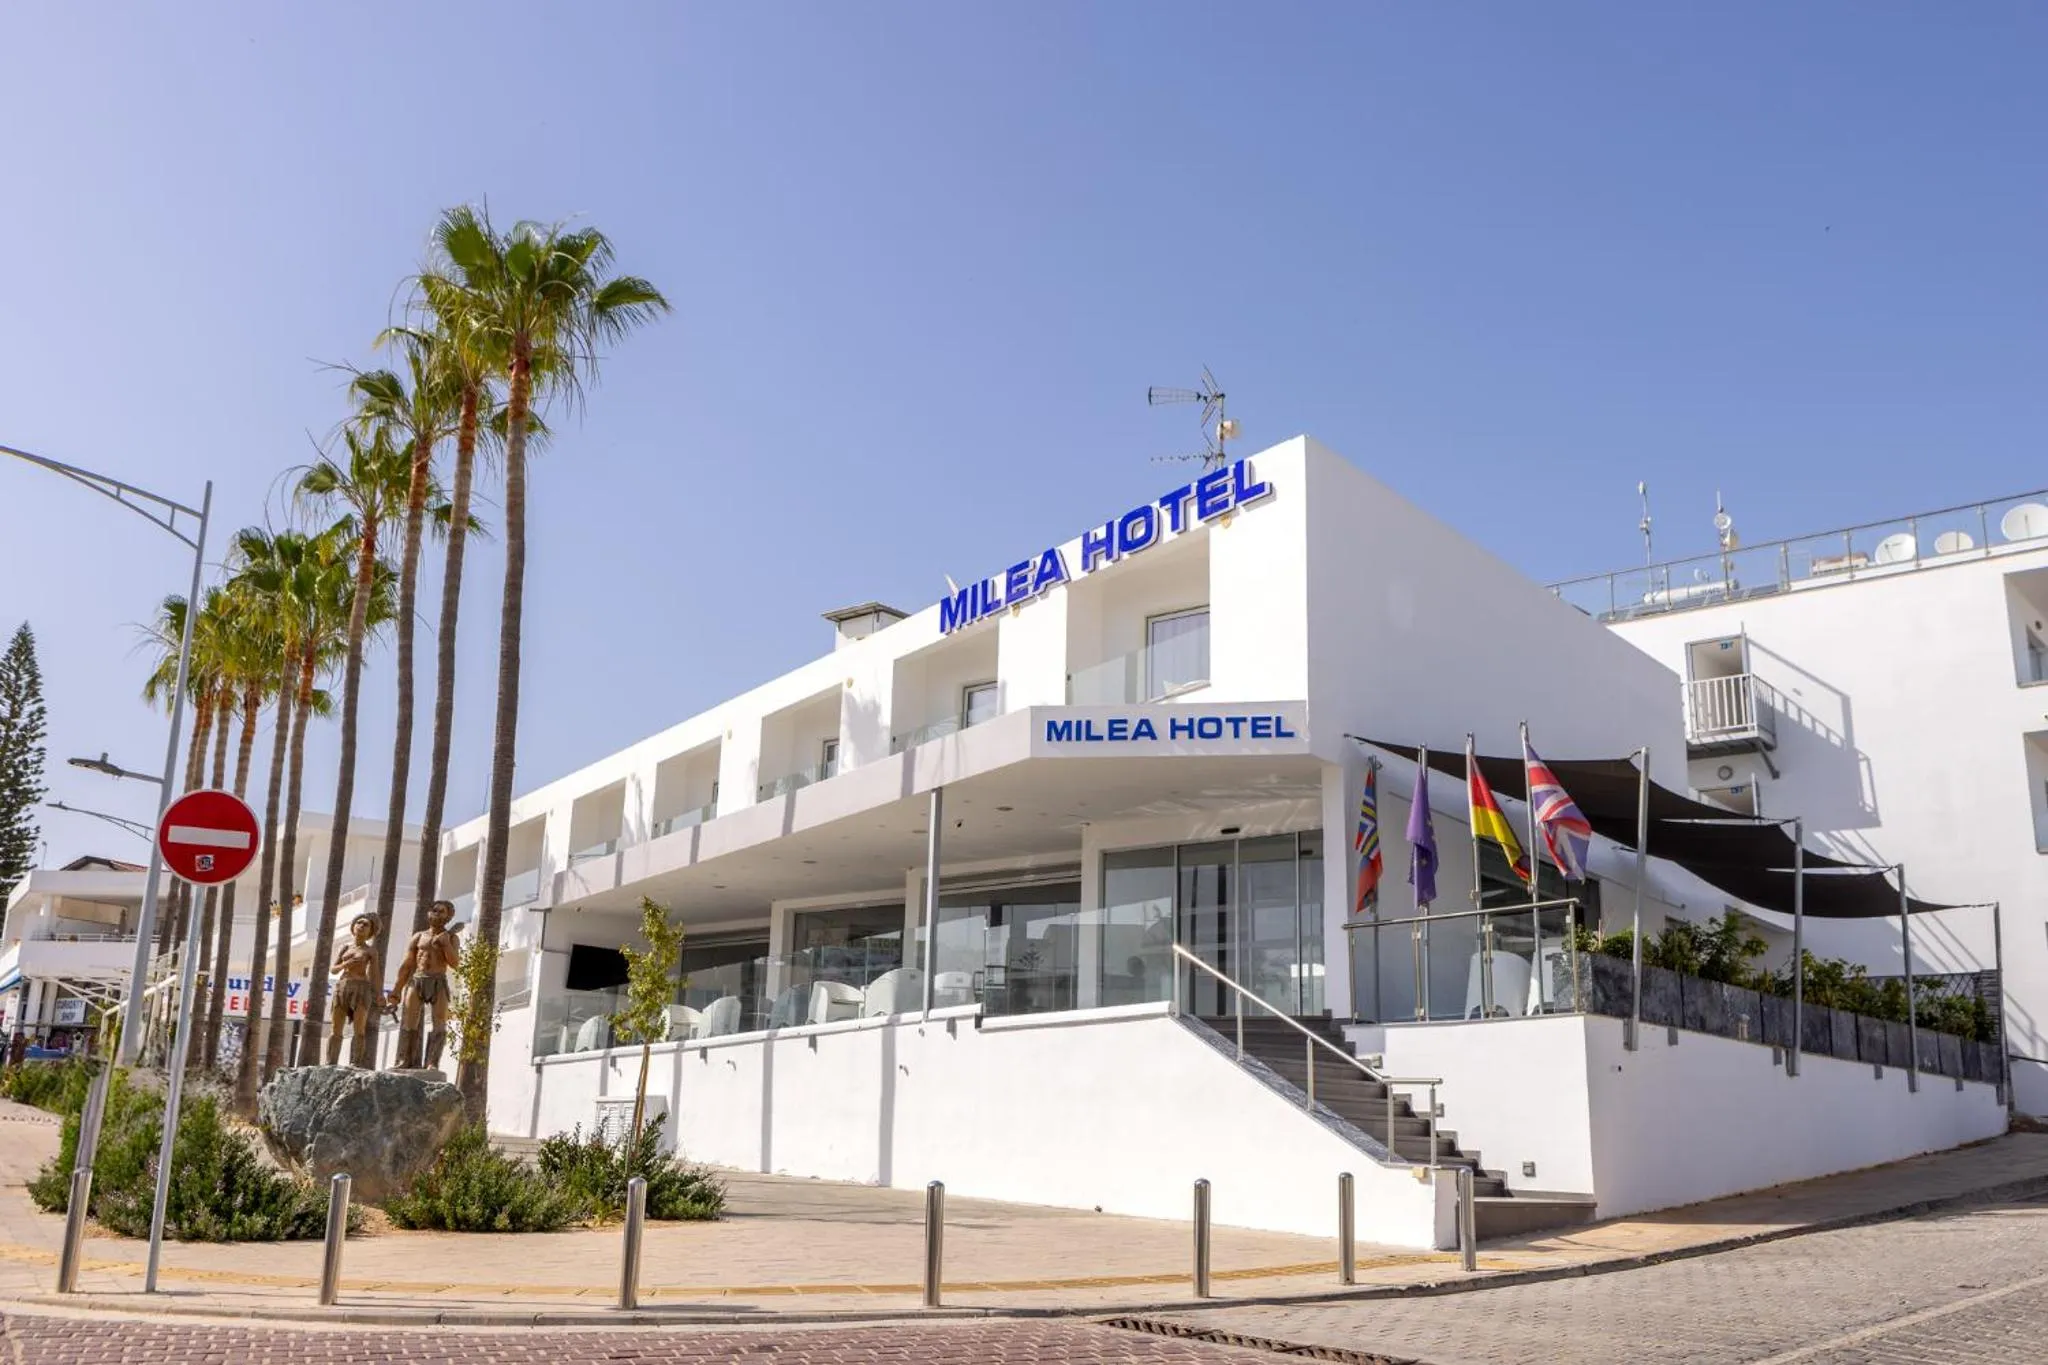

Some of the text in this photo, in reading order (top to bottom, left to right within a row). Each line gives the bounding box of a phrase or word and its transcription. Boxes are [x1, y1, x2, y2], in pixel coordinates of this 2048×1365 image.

[939, 459, 1271, 635] MILEA HOTEL
[1046, 715, 1295, 742] MILEA HOTEL
